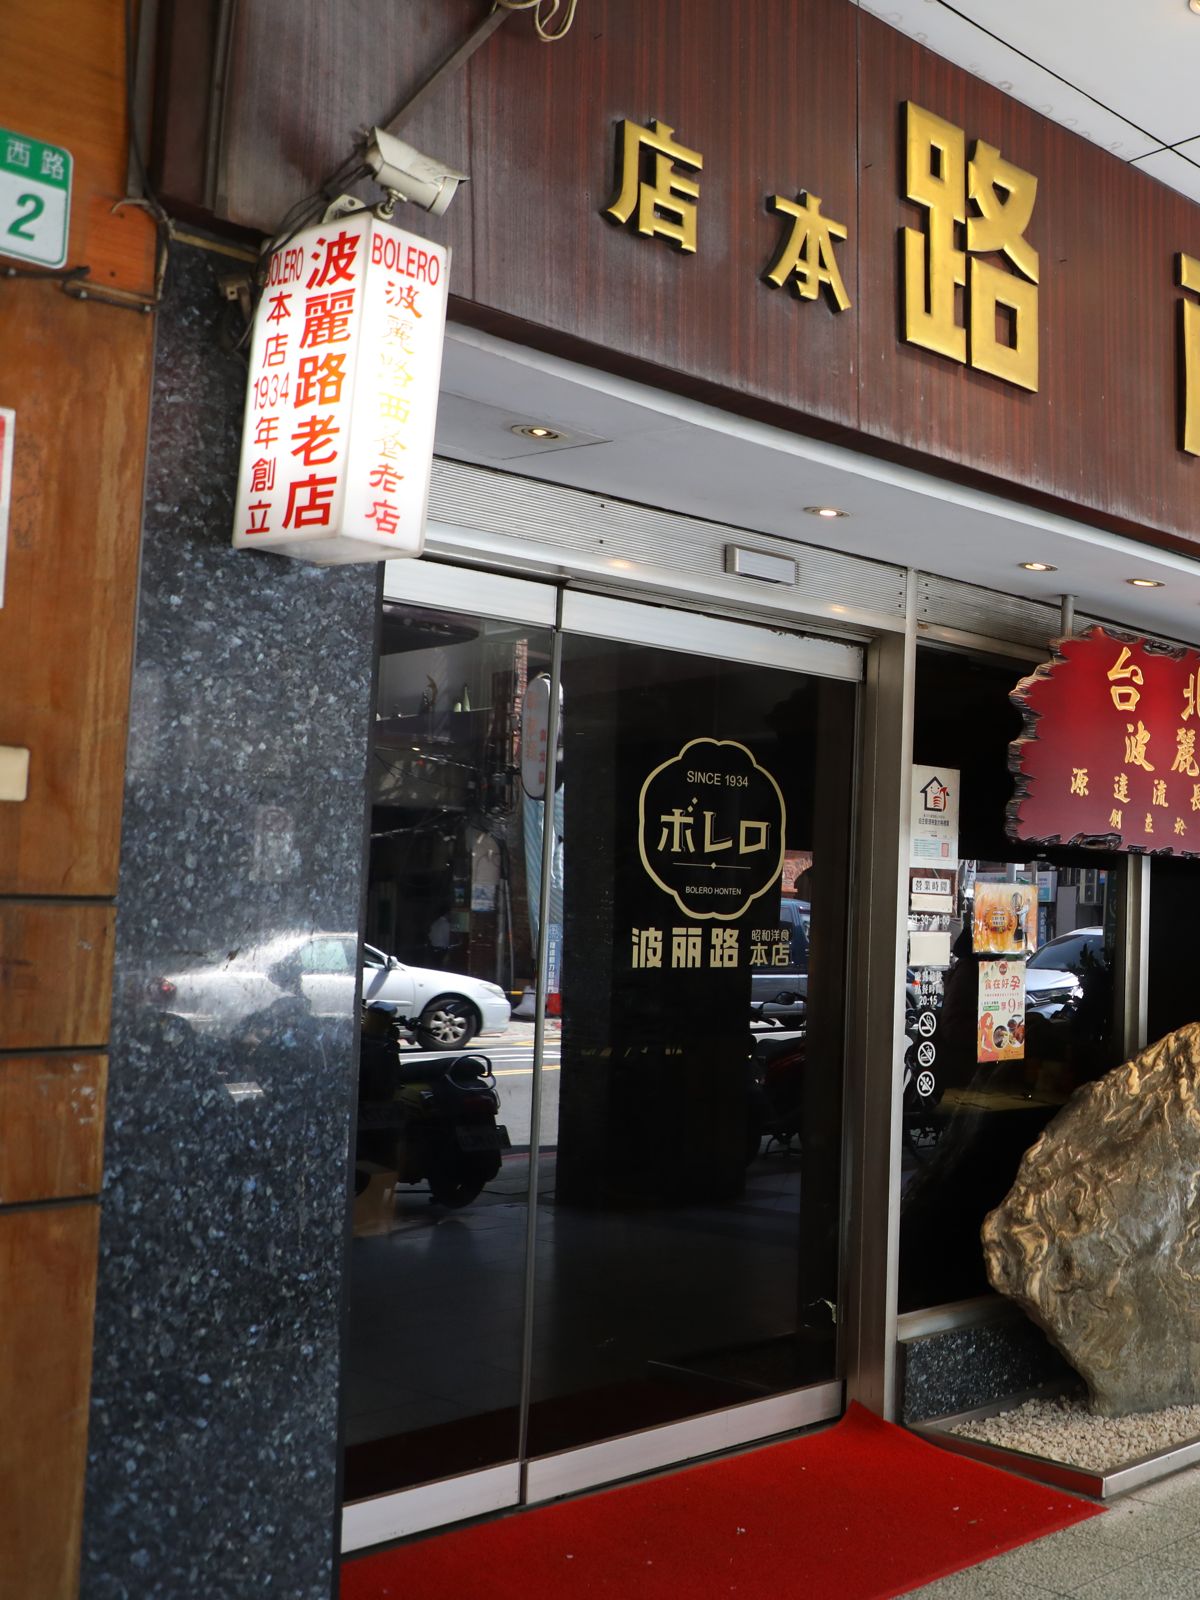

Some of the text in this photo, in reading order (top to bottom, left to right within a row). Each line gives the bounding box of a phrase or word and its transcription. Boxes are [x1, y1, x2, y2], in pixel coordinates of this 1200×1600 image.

[6, 138, 65, 181] 西路
[7, 193, 45, 241] 2
[371, 233, 440, 286] BOLERO
[281, 231, 361, 529] 波麗路老店
[245, 291, 293, 535] 本店1934年創立
[687, 770, 749, 787] SINCE 1934
[657, 797, 771, 854] ボレロ
[685, 886, 742, 896] BOLERO HONTEN
[750, 942, 790, 967] 本店
